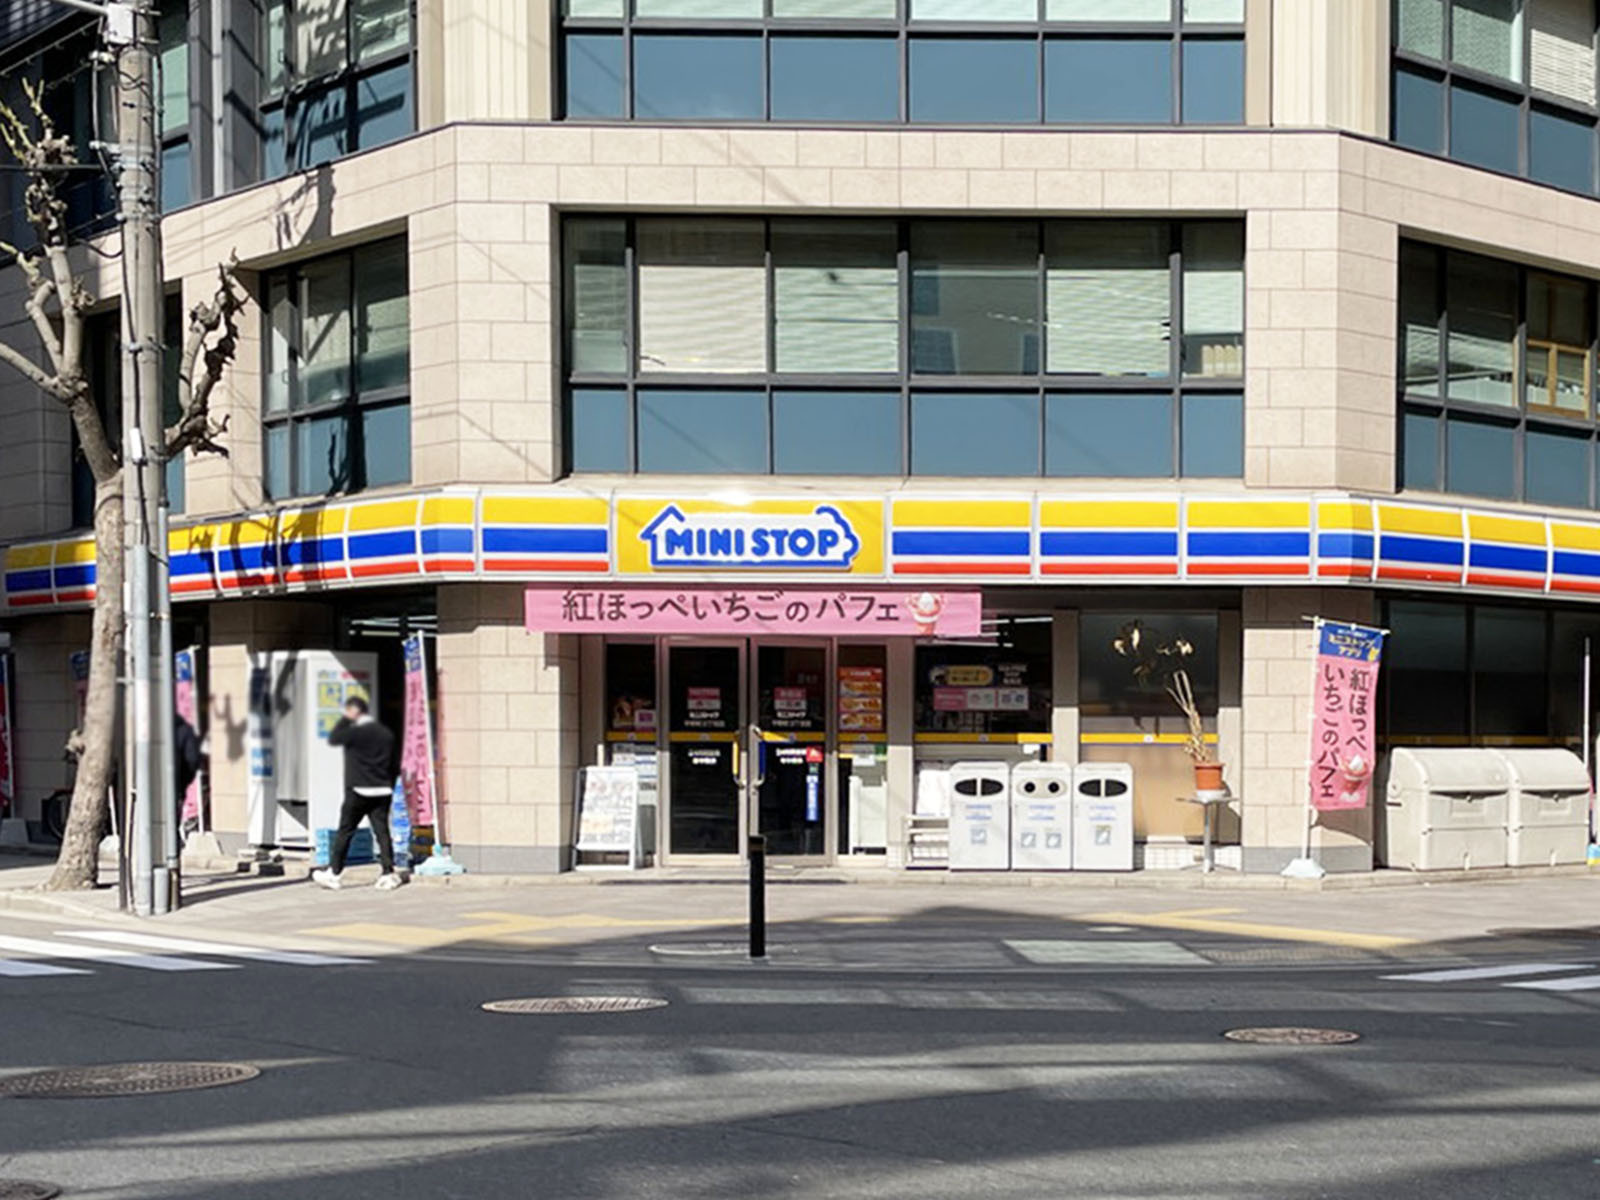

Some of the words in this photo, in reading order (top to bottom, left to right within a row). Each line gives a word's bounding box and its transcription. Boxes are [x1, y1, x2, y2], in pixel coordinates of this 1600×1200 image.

[665, 527, 745, 557] MINI
[751, 527, 839, 557] STOP
[562, 589, 900, 623] 紅ほっぺいちごのパフェ
[1317, 663, 1345, 797] いちごのパフェ
[1346, 668, 1370, 751] 紅ほっぺ
